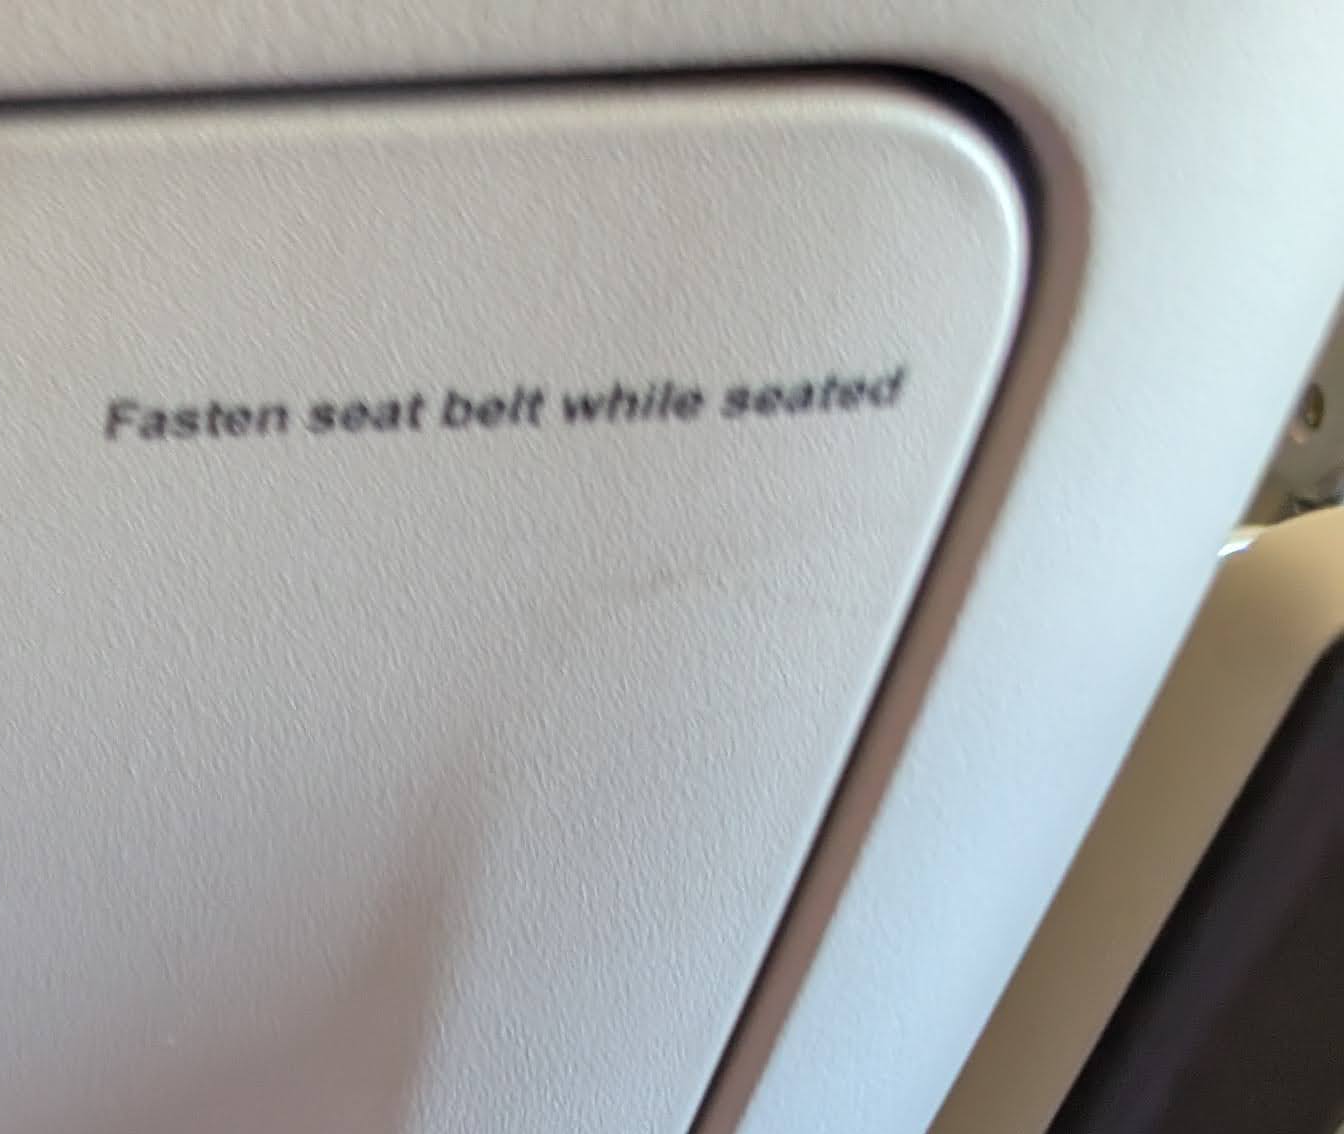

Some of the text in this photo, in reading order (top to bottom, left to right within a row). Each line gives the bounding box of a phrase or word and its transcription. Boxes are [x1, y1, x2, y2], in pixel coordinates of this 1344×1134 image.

[105, 367, 907, 441] Fasten seat belt while seated
